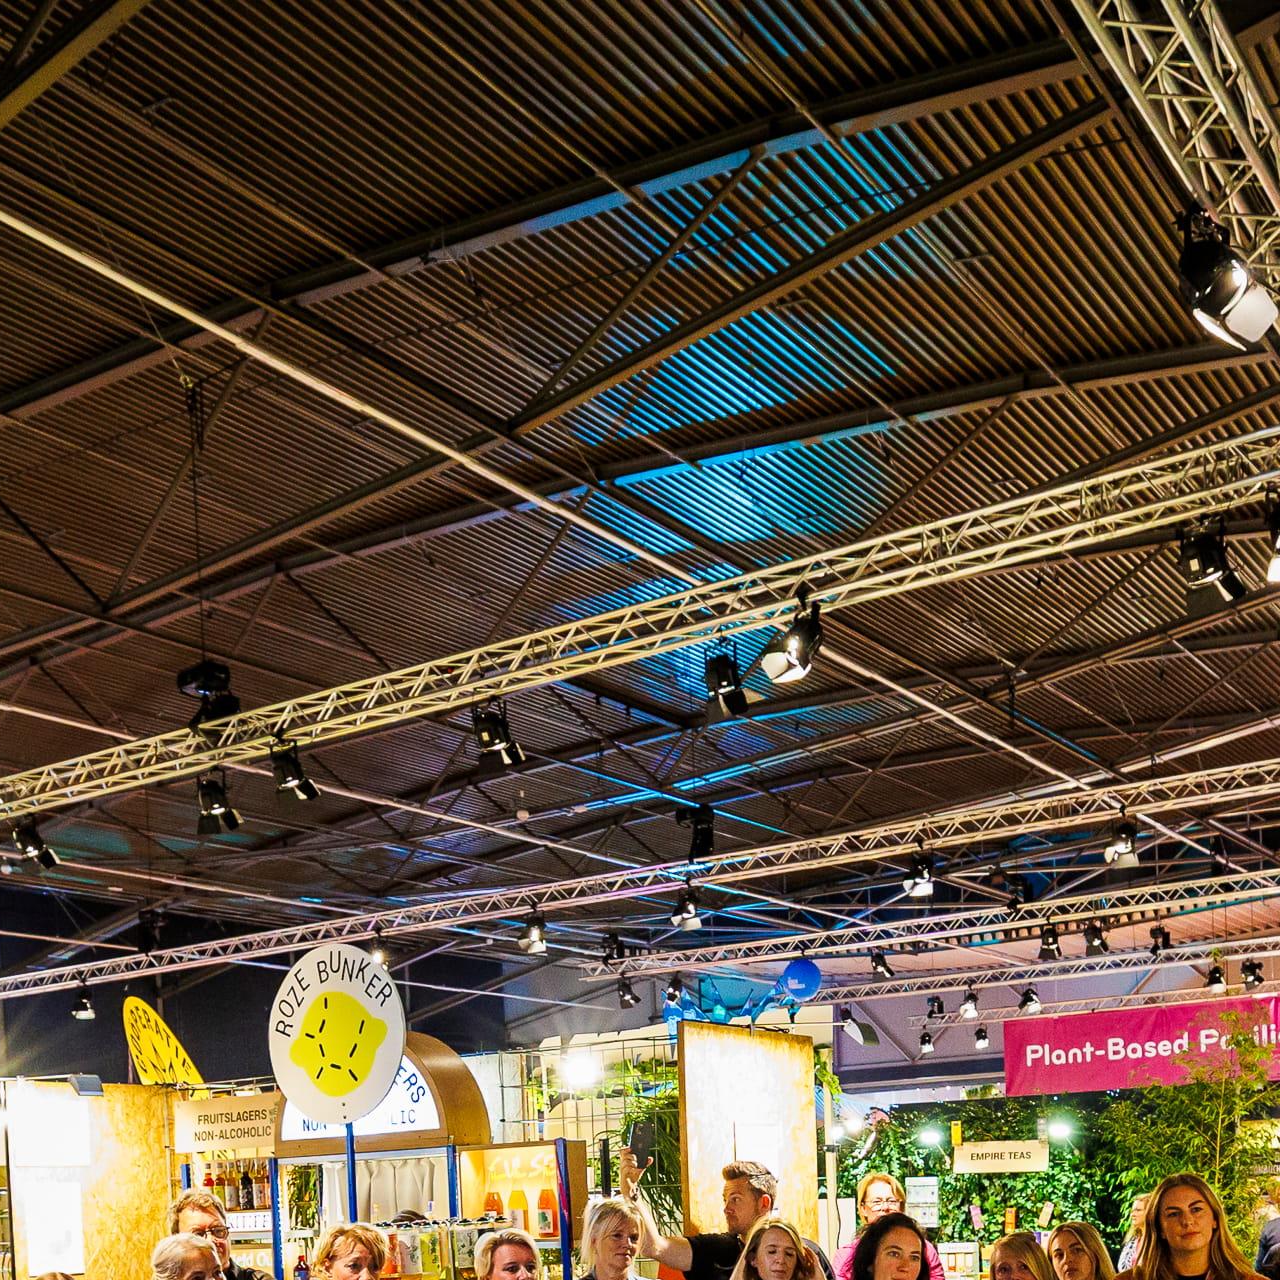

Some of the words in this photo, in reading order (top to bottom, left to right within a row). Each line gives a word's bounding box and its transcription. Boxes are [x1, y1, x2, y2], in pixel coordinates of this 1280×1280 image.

[275, 968, 311, 1038] ROZE
[316, 950, 394, 1008] BUNKER
[1025, 1032, 1190, 1067] Plant-Based
[197, 1110, 268, 1125] FRUITSLAGERS
[194, 1125, 272, 1142] NON-ALCOHOLIC
[970, 1151, 1006, 1161] EMPIRE
[1008, 1151, 1032, 1160] TEAS
